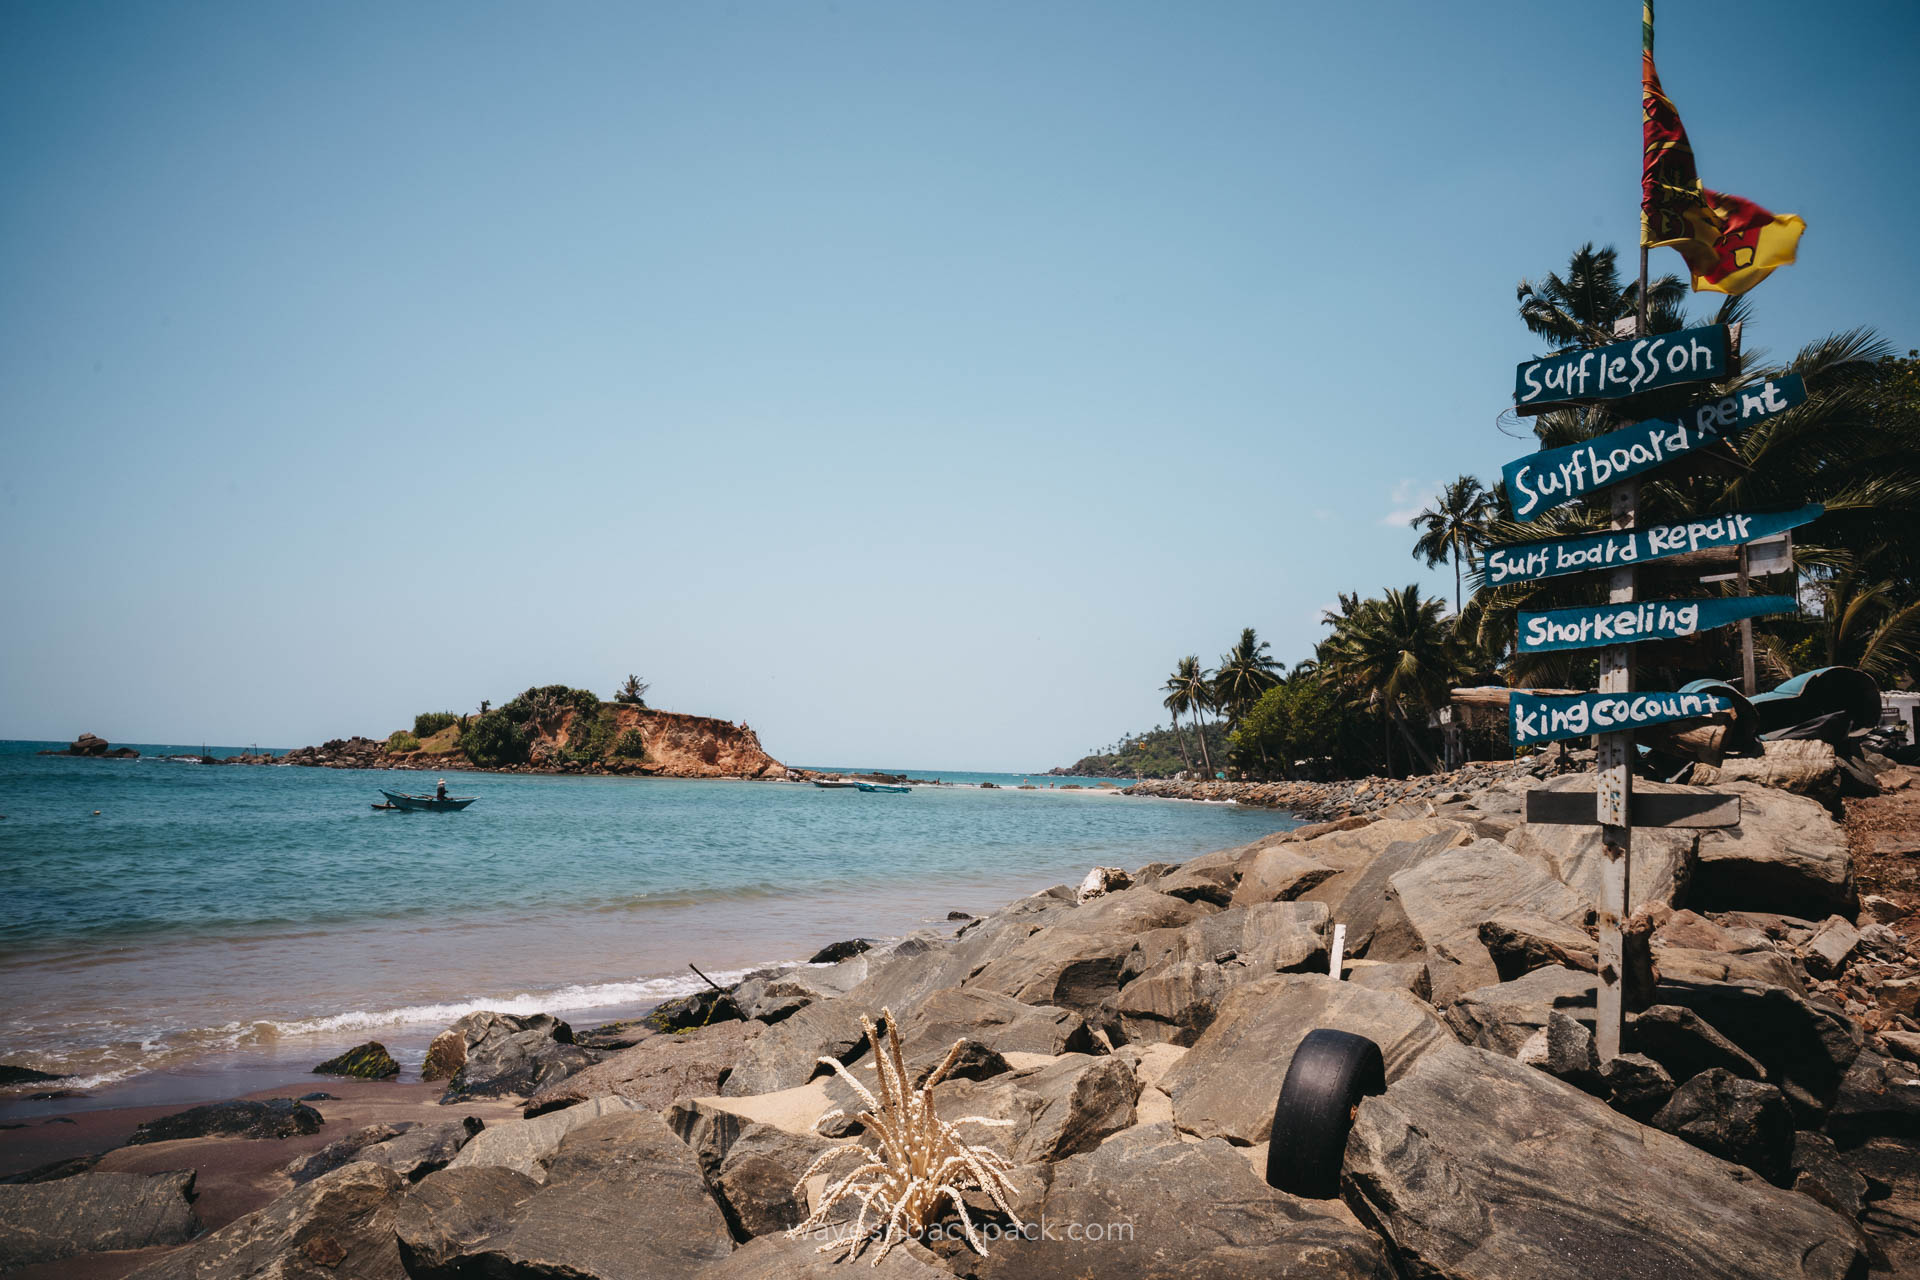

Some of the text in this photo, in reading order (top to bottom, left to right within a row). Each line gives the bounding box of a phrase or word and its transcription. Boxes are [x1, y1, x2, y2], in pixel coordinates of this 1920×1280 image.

[1521, 352, 1594, 401] Surf
[1697, 382, 1788, 440] Rent
[1648, 514, 1752, 554] Repair
[1526, 604, 1698, 646] Snorkeling
